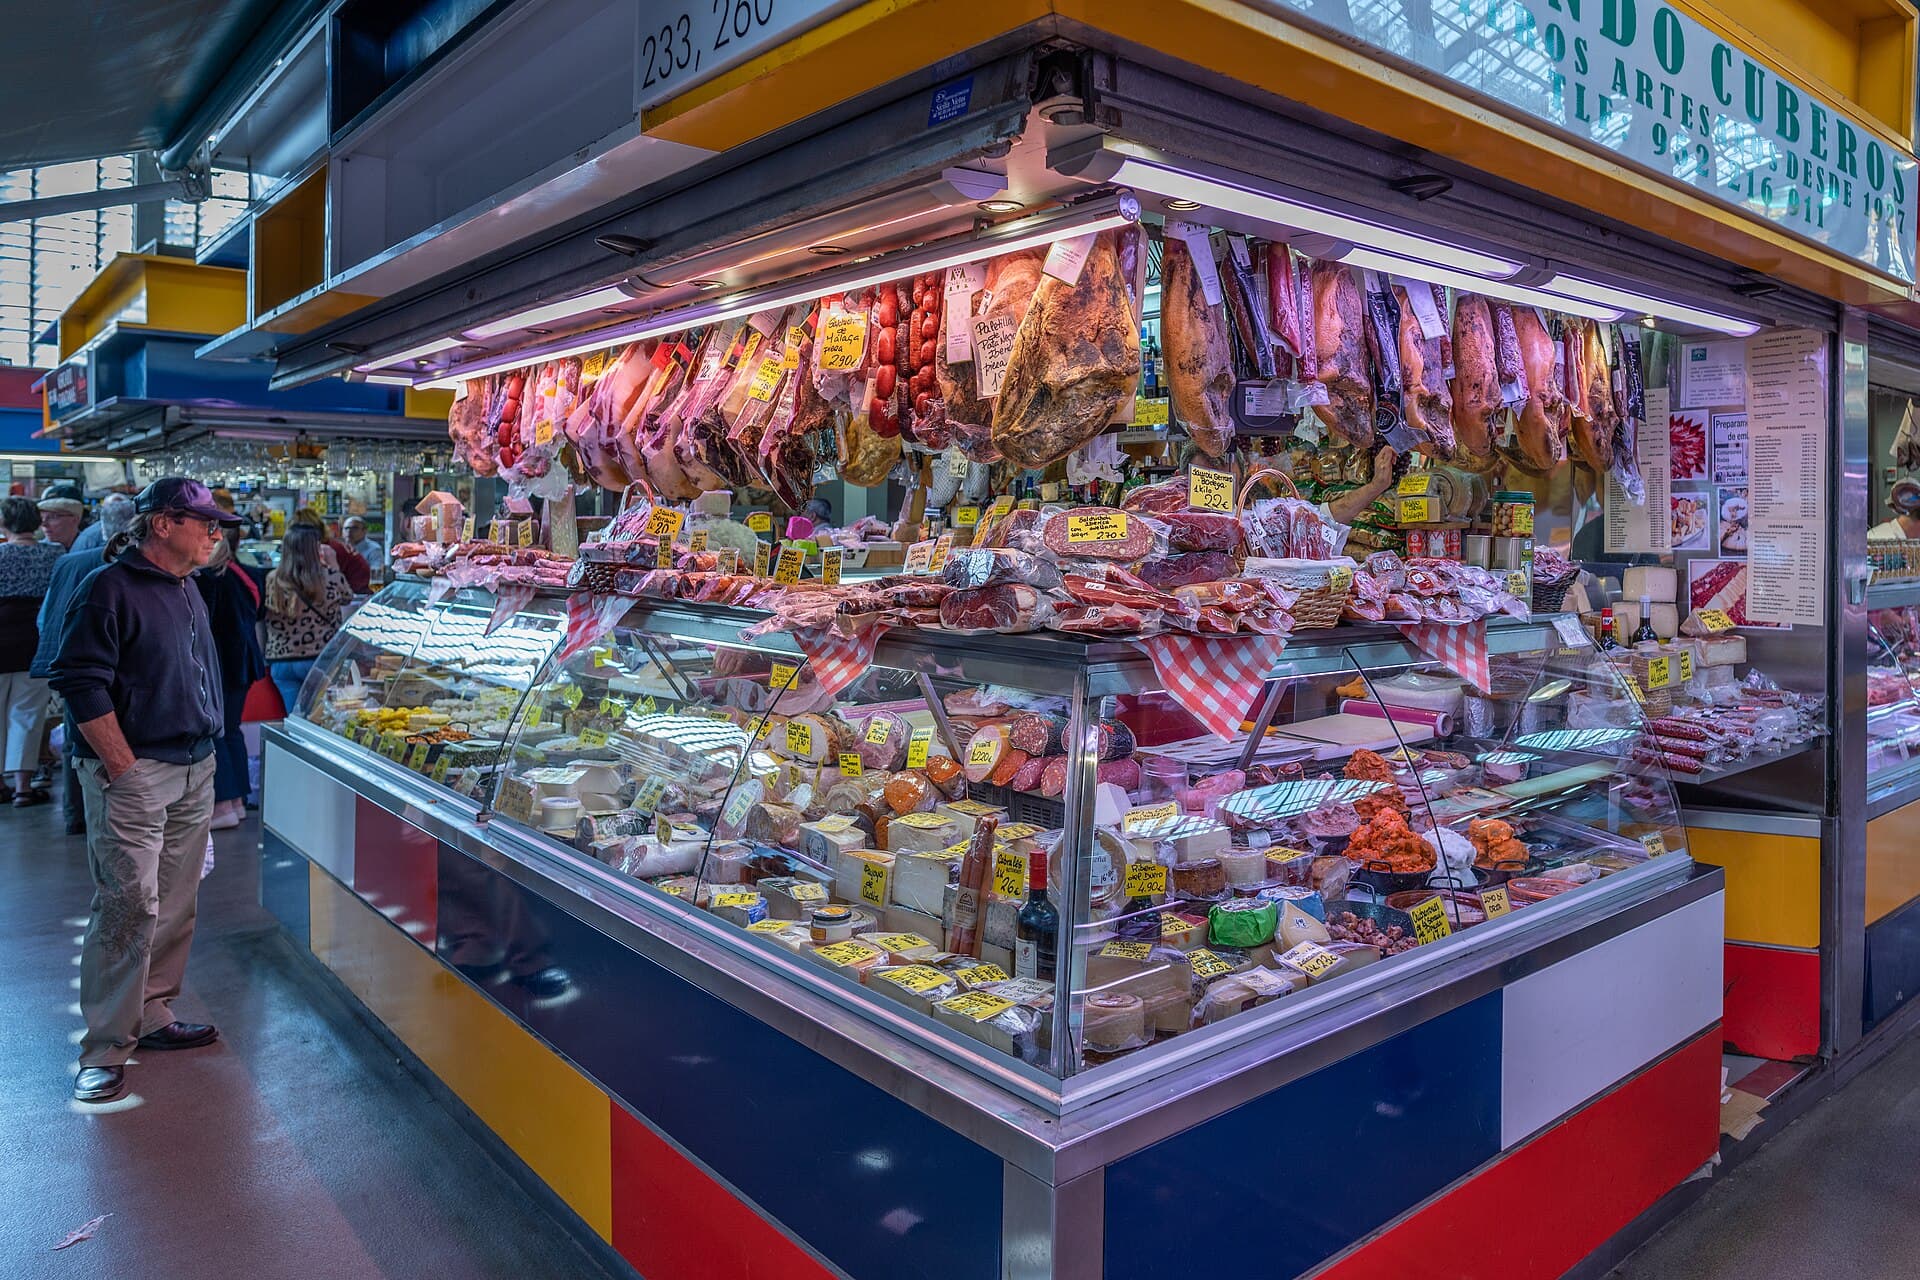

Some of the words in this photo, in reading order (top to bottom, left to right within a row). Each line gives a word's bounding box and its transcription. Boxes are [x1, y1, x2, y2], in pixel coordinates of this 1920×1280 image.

[642, 14, 700, 90] 233,
[1711, 43, 1905, 205] CUBEROS
[1786, 150, 1853, 209] DESDE
[1788, 187, 1824, 229] 911
[1727, 431, 1736, 440] de
[998, 854, 1023, 869] Cabrales
[1131, 864, 1156, 873] Ribera
[1128, 873, 1142, 881] del
[1143, 870, 1163, 881] Duero
[865, 881, 873, 889] de
